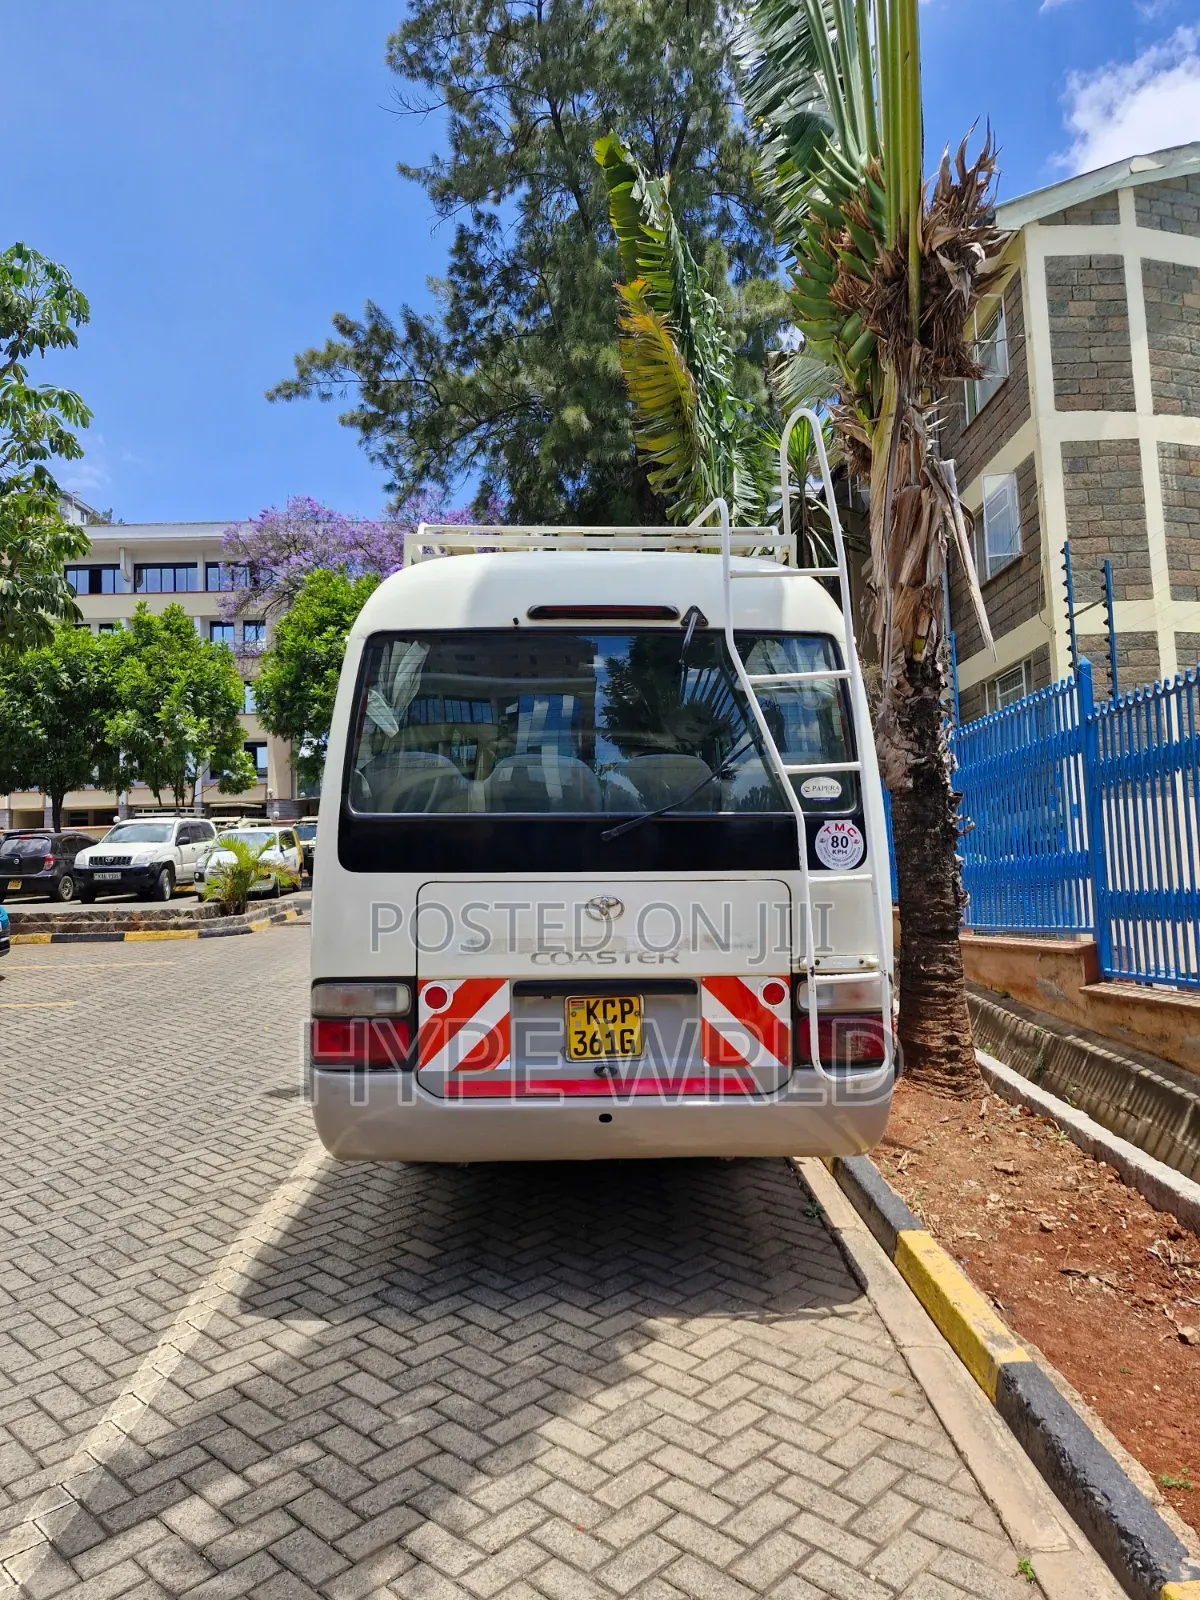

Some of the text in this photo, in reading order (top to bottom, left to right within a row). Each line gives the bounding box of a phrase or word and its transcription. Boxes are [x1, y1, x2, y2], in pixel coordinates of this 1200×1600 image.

[823, 823, 857, 838] TMC
[830, 835, 849, 849] 80
[530, 950, 680, 966] COASTER
[586, 998, 634, 1025] KCP
[573, 1028, 636, 1056] 361G
